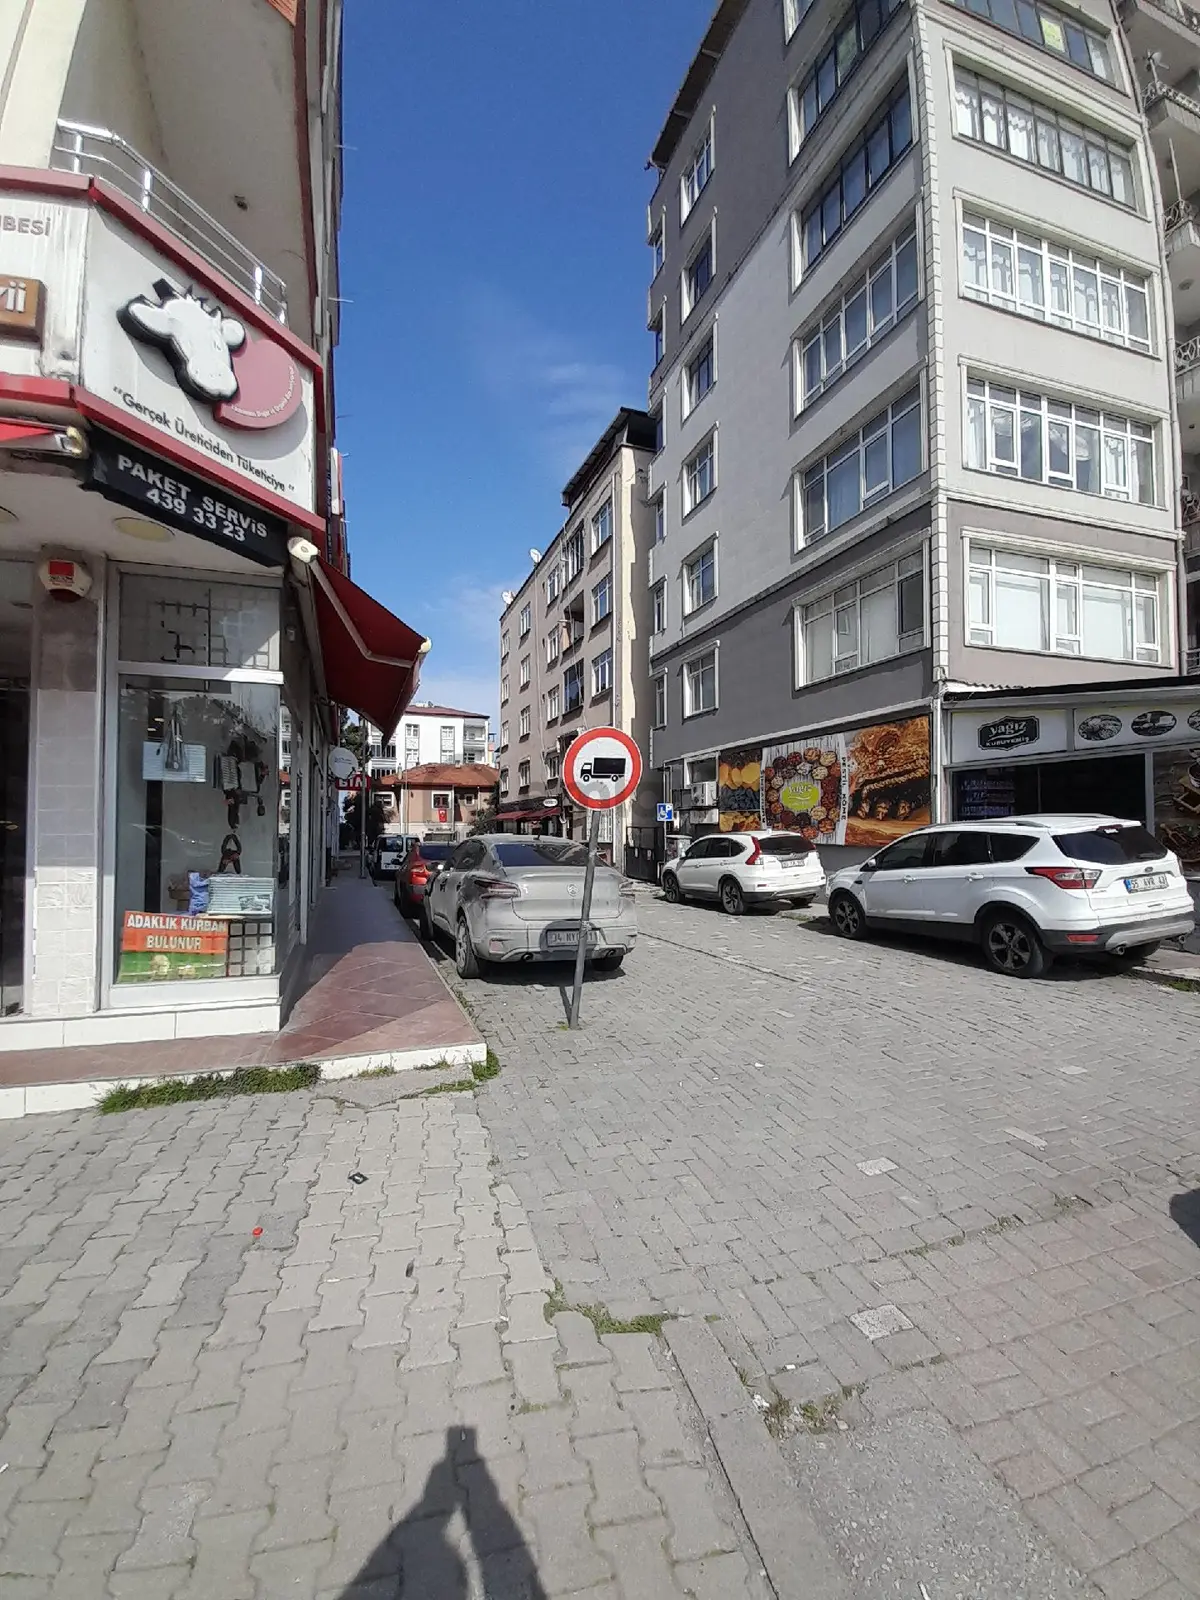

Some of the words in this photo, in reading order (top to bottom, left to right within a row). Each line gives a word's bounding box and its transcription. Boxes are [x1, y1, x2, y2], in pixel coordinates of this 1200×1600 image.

[0, 215, 51, 236] BESİ
[118, 454, 192, 500] PAKET
[146, 488, 186, 515] 439
[192, 507, 217, 530] 33
[222, 520, 245, 542] 23
[126, 914, 178, 930] ADAKLIK
[181, 918, 227, 933] KURBAN
[146, 935, 202, 950] BULUNUR
